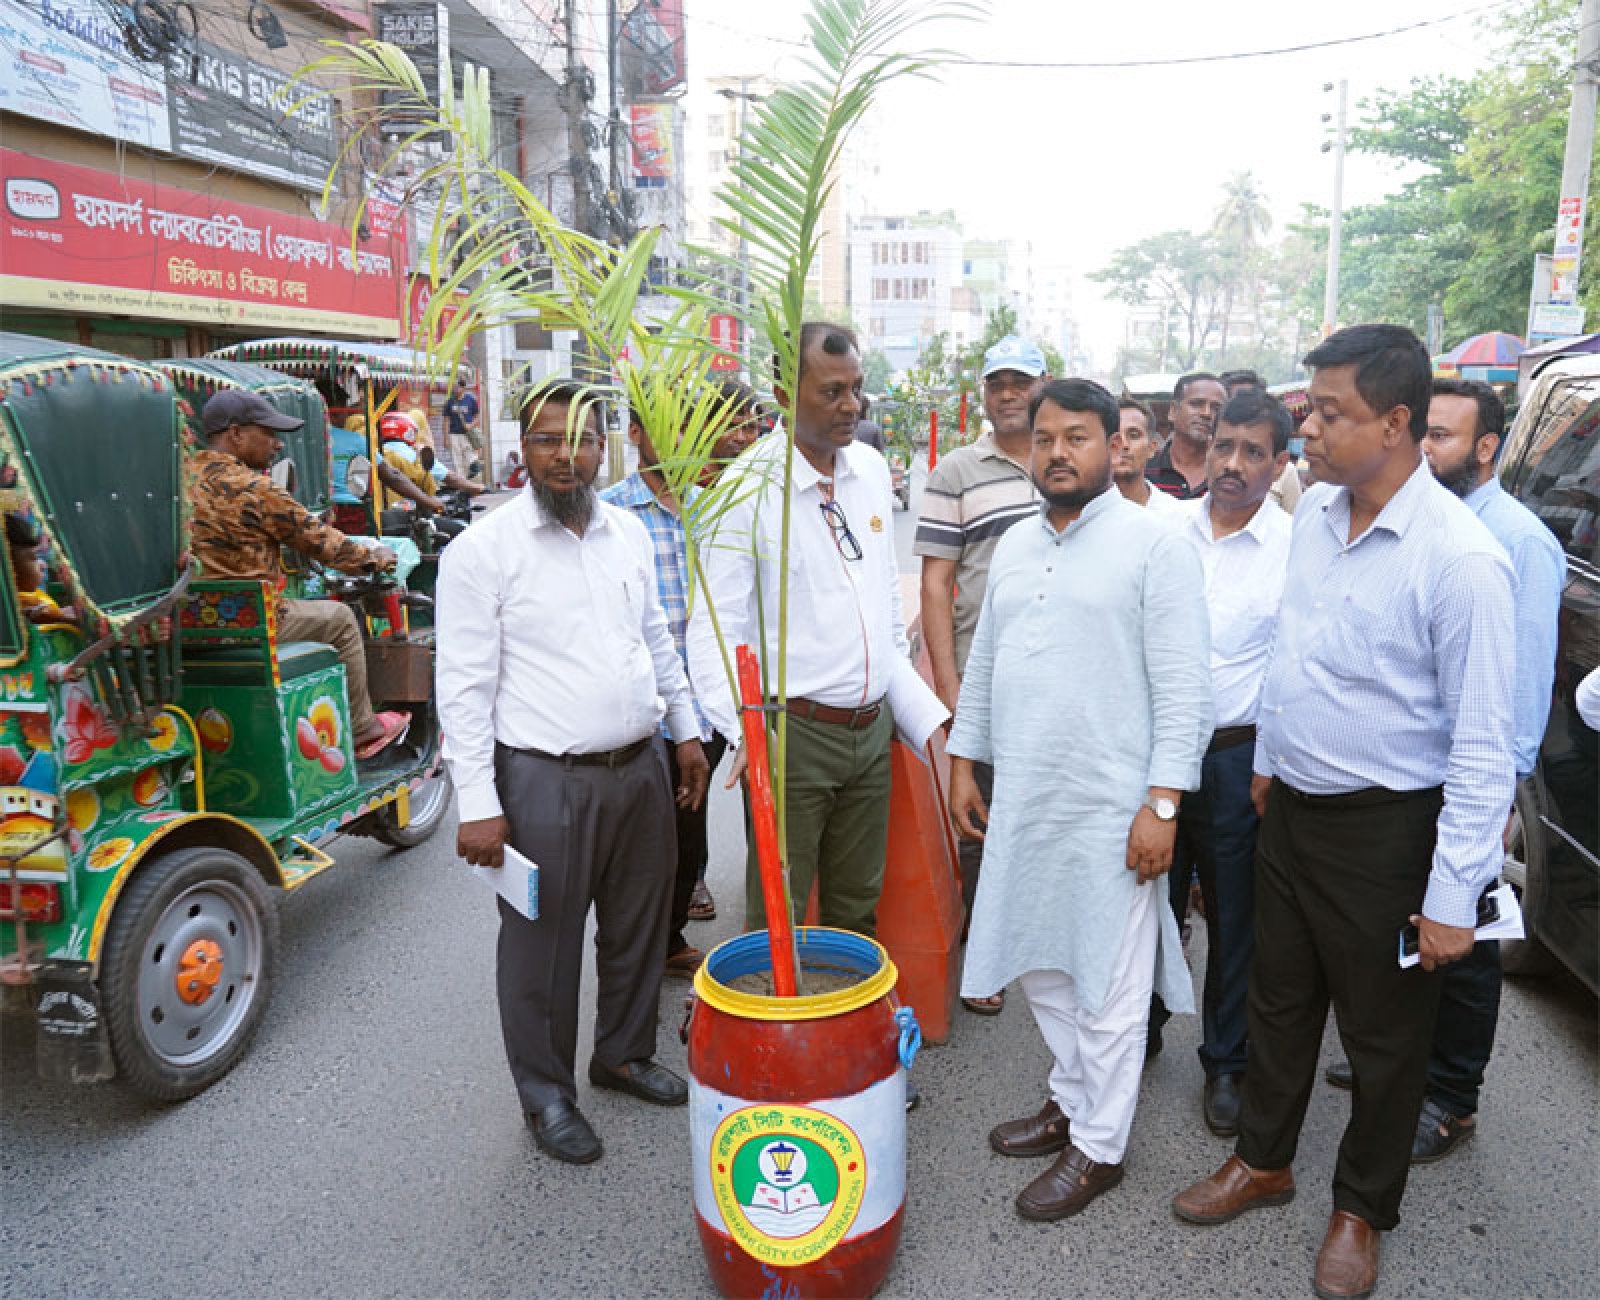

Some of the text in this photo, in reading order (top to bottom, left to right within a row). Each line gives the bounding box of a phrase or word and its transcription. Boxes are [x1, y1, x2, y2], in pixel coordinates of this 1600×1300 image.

[72, 192, 144, 236] হামদর্দ
[167, 256, 223, 289] চিকিৎসা
[226, 271, 237, 291] ও
[752, 1110, 784, 1129] সিটি
[757, 1244, 789, 1262] CITY
[792, 1179, 862, 1261] CORPORATION
